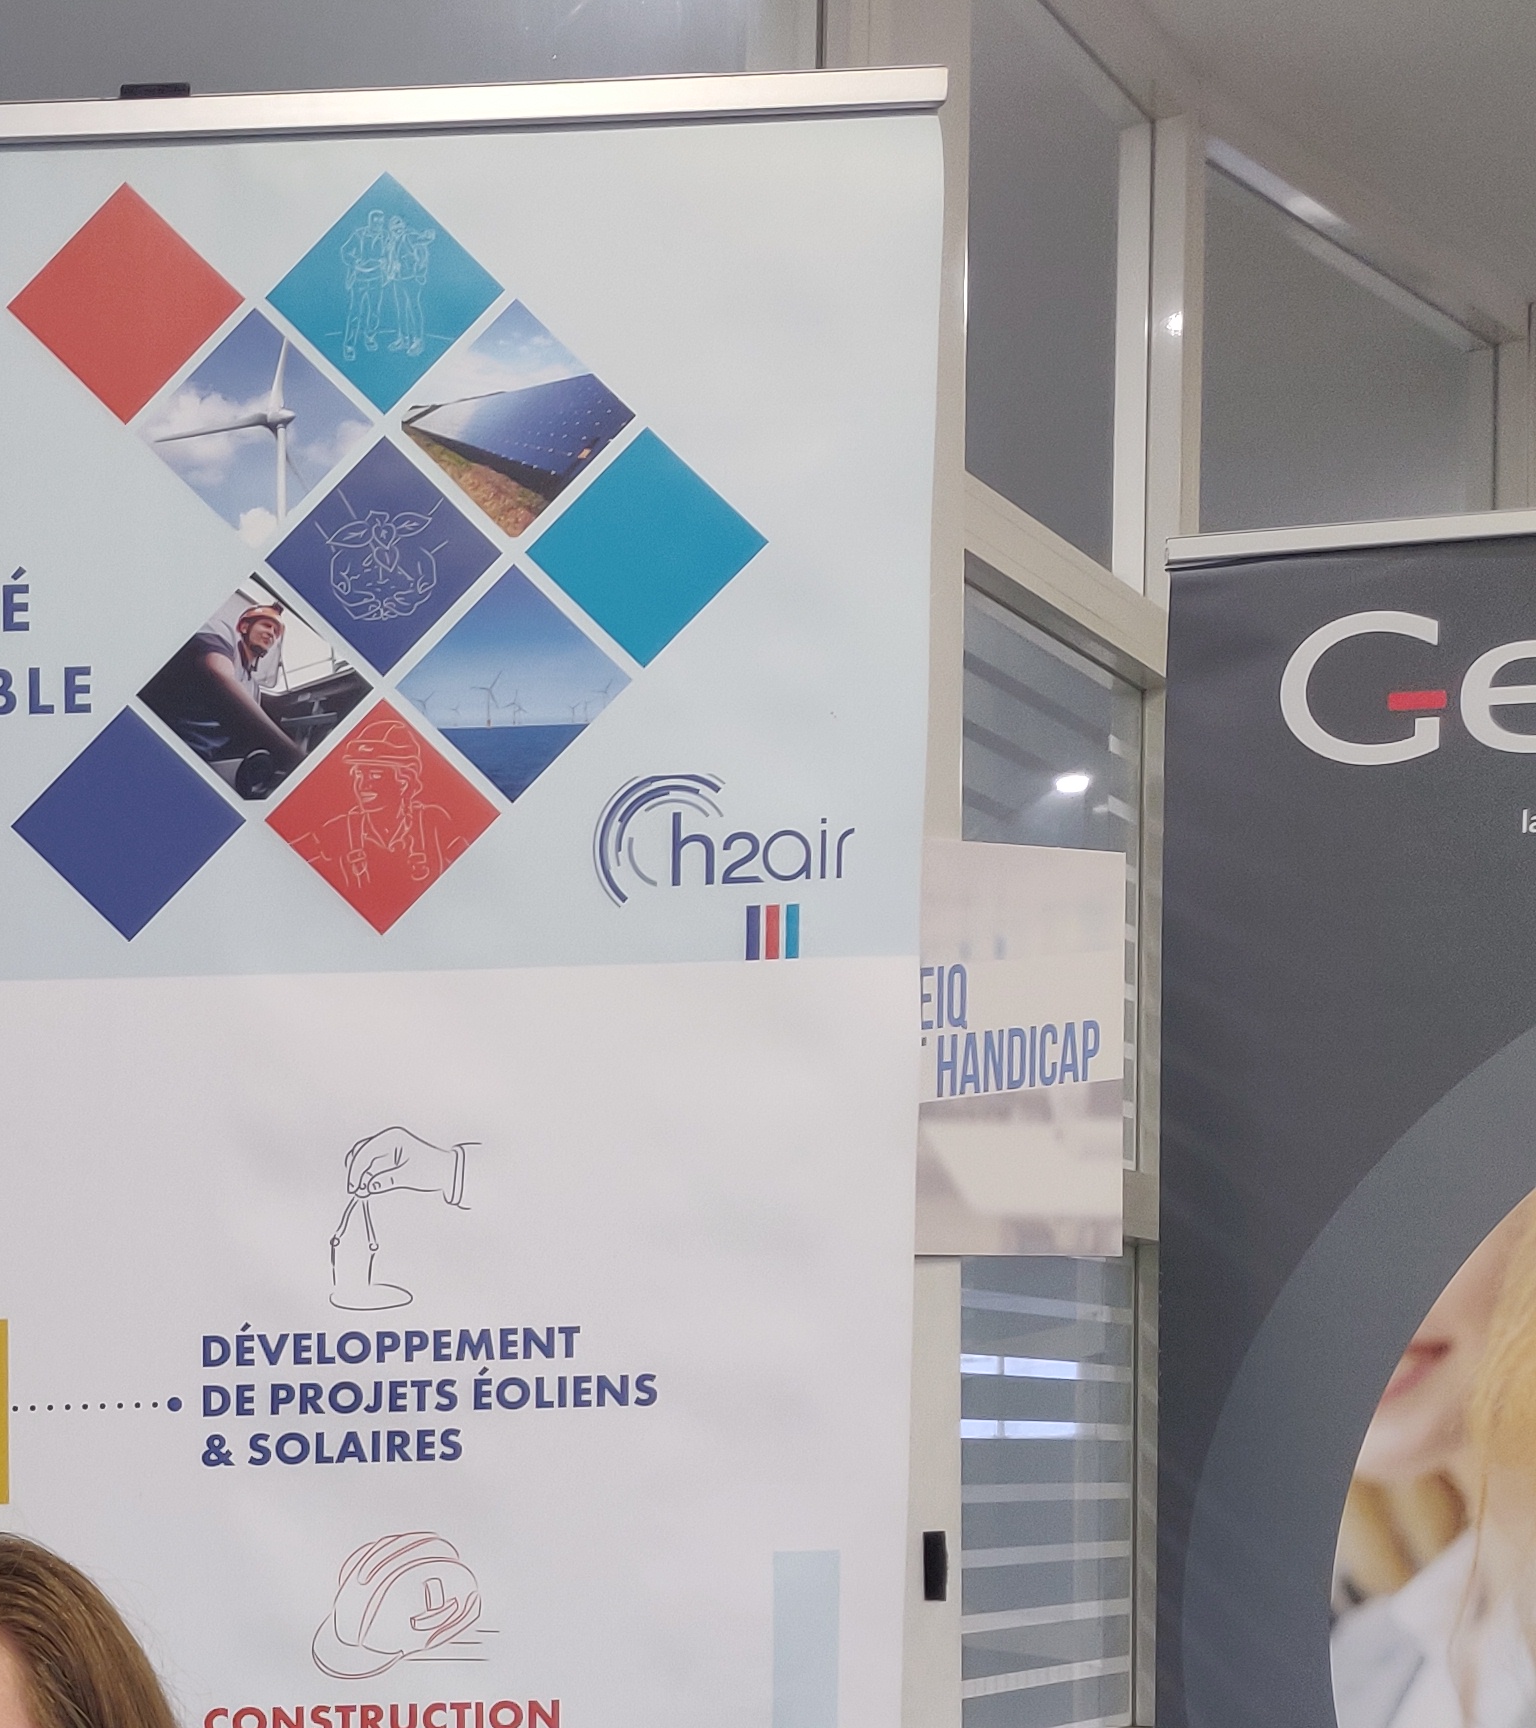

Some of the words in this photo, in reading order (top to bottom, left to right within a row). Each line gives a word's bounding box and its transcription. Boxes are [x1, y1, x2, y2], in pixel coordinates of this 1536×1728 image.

[670, 811, 856, 888] h2air
[919, 963, 968, 1030] EIQ
[936, 1019, 1100, 1098] HANDICAP
[201, 1322, 581, 1367] DÉVELOPPEMENT
[202, 1383, 256, 1416] DE
[269, 1377, 459, 1416] PROJETS
[472, 1366, 658, 1411] ÉOLIENS
[201, 1433, 235, 1467] &
[247, 1428, 463, 1466] SOLAIRES
